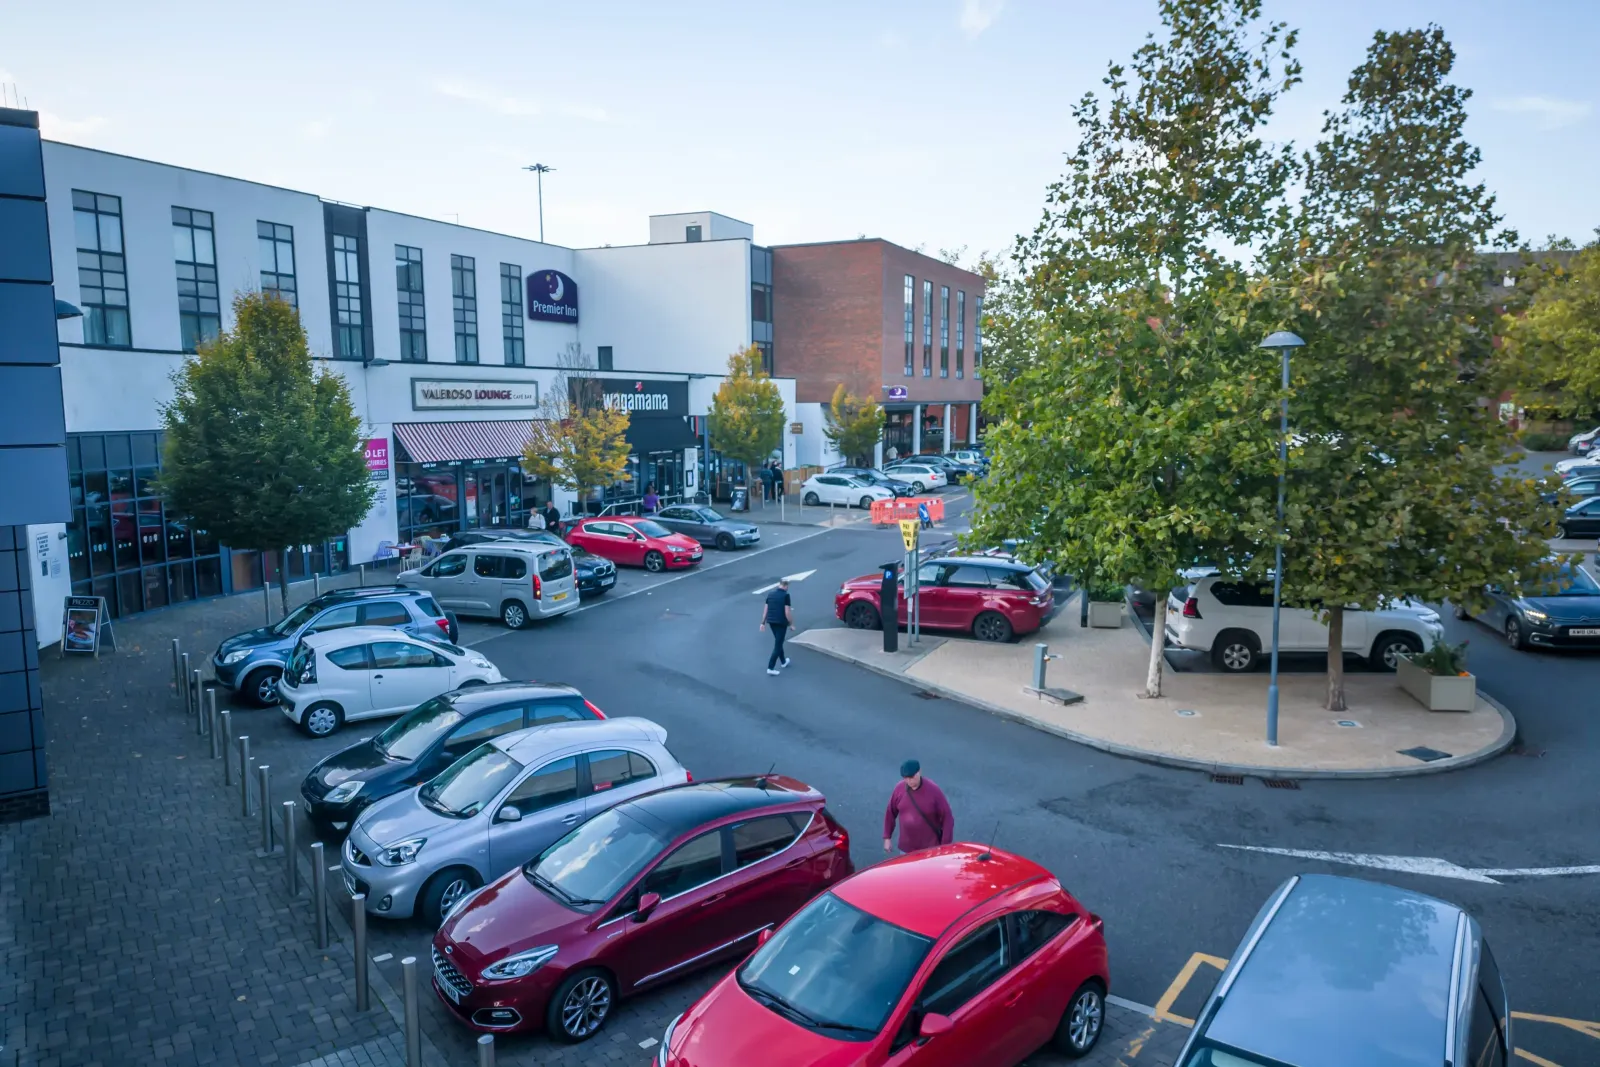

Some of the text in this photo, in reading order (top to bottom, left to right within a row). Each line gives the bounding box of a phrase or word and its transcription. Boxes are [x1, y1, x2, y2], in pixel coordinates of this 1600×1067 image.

[533, 300, 576, 317] Premier Inn
[421, 389, 472, 400] VALEROSO
[474, 390, 512, 400] LOUNGE
[603, 393, 669, 415] wagamama
[372, 448, 386, 458] LET
[885, 570, 892, 579] P
